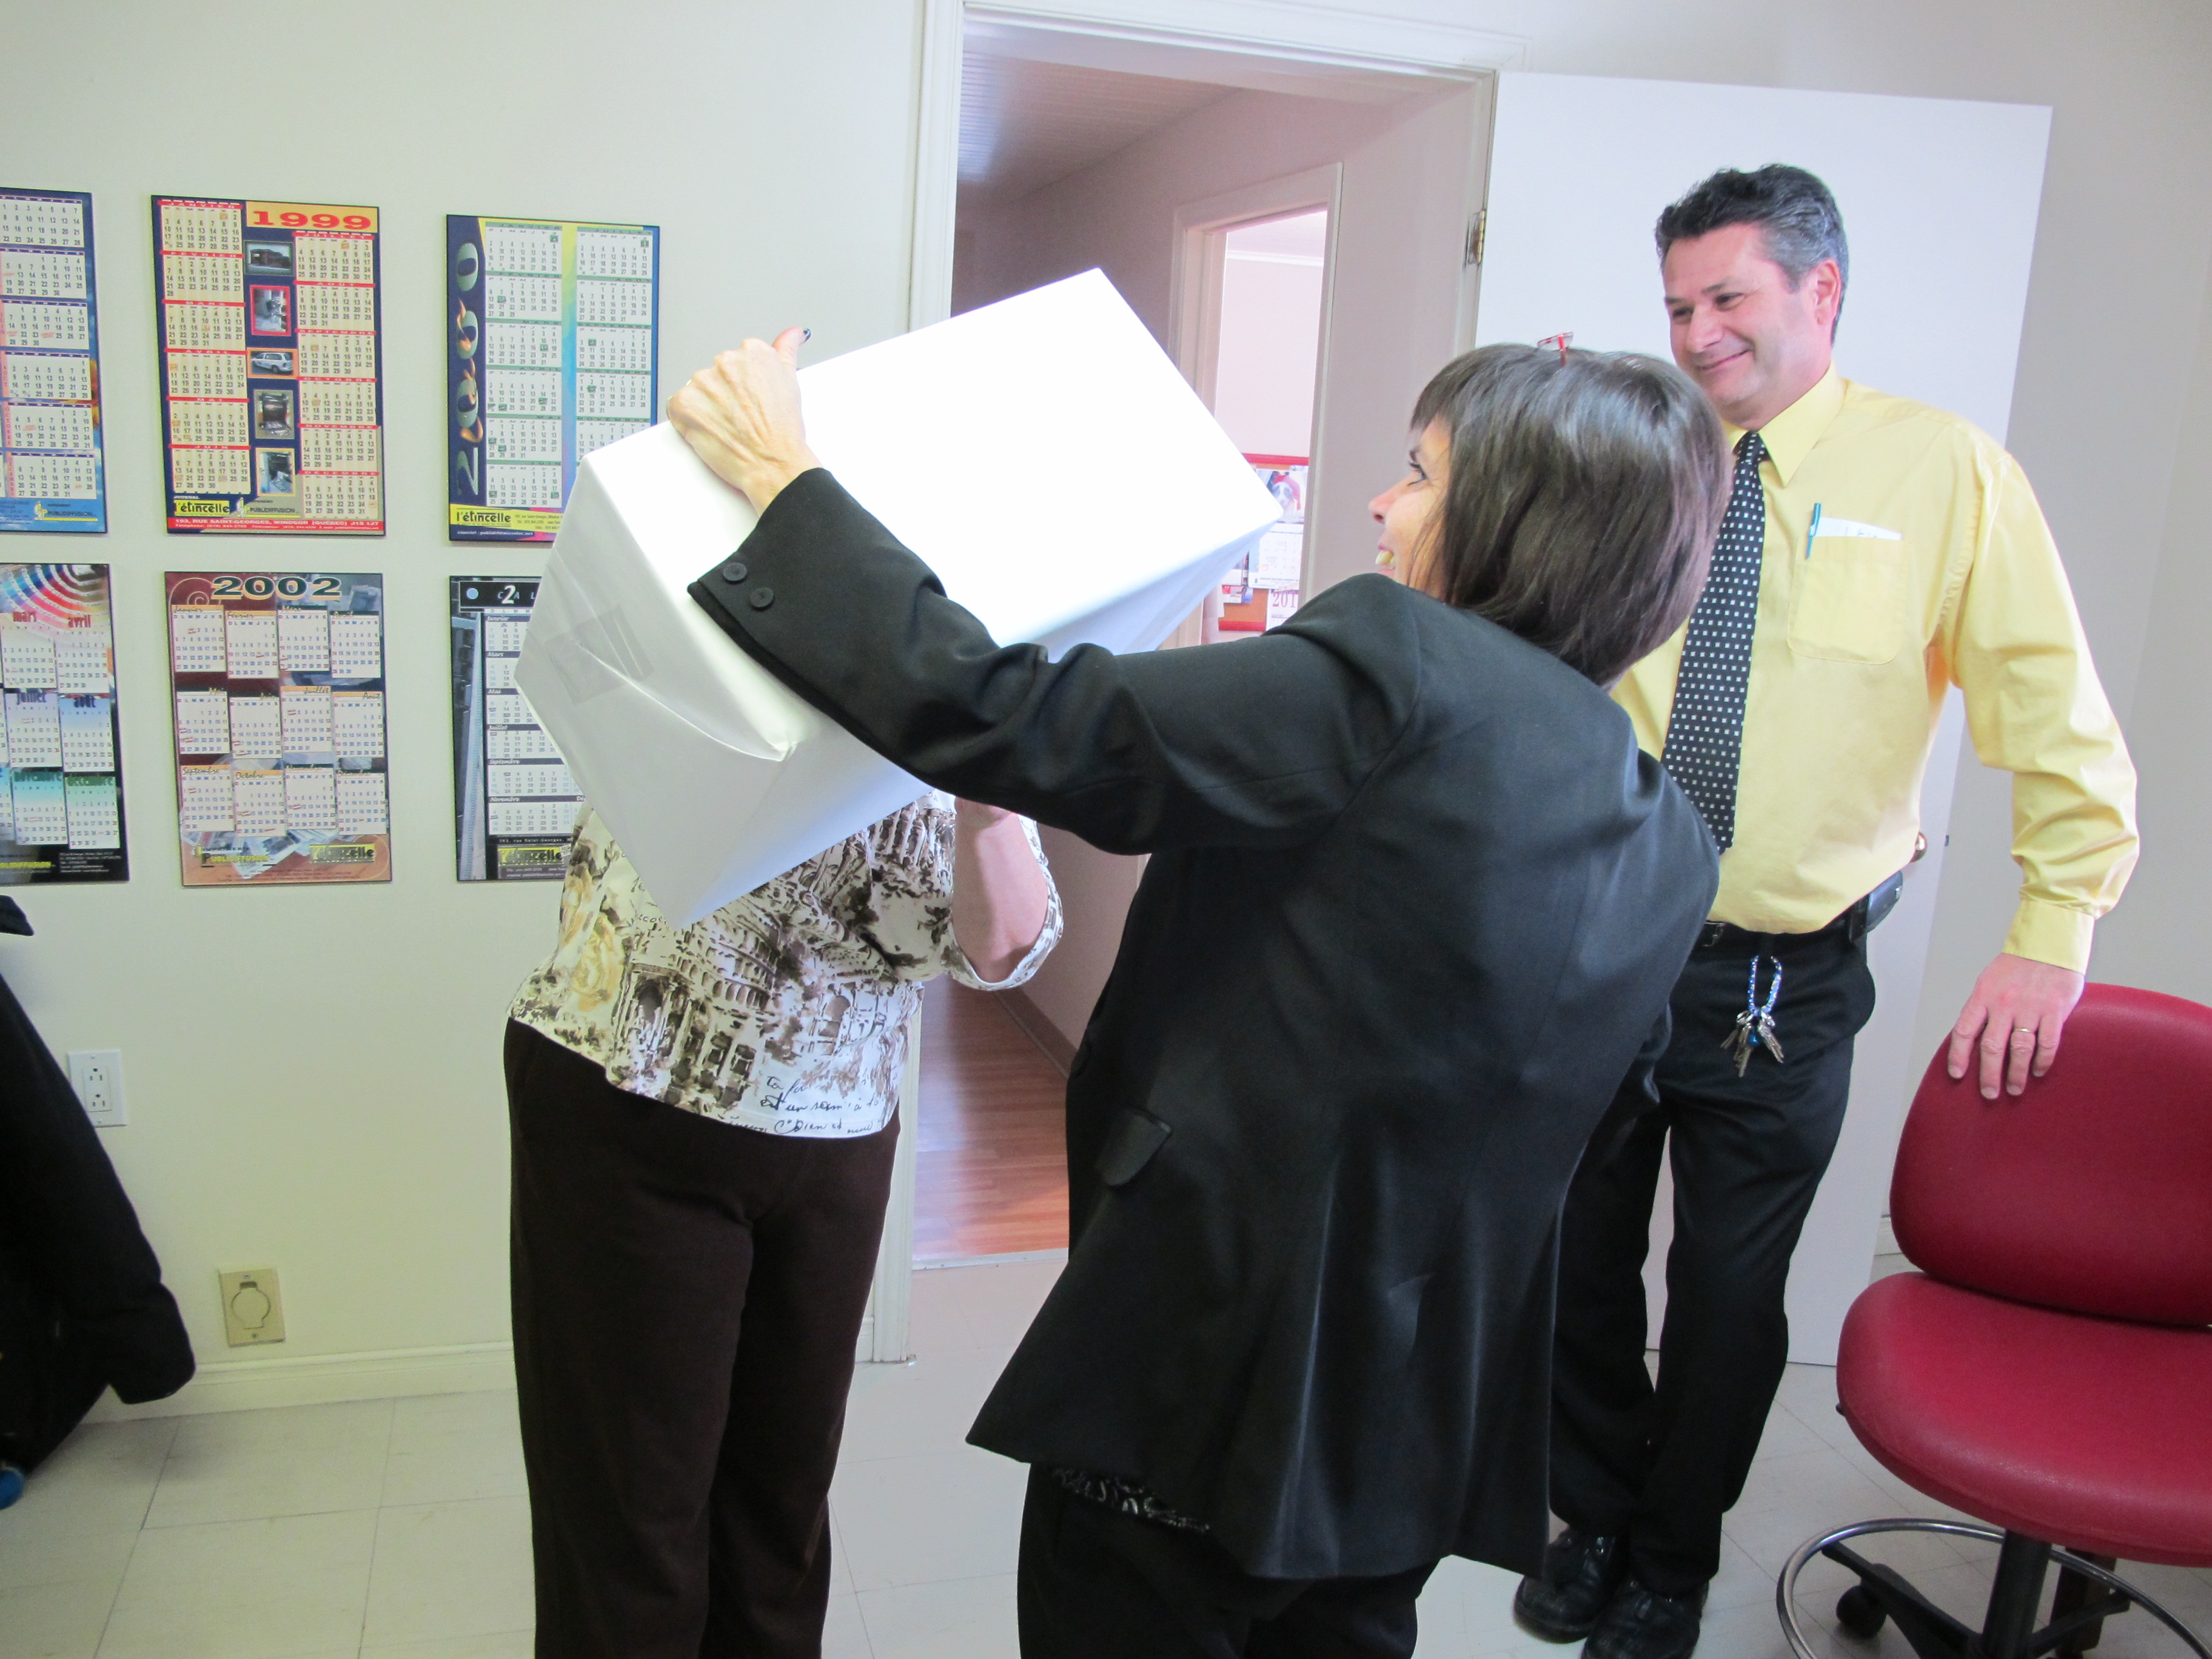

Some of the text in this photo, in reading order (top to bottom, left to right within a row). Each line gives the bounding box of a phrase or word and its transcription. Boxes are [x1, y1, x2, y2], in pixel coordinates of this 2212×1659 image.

[253, 210, 372, 230] 1999
[457, 243, 479, 496] 2000
[457, 511, 511, 523] l'étincelle
[211, 575, 343, 601] 2002
[501, 585, 517, 605] 2
[68, 614, 92, 628] avril
